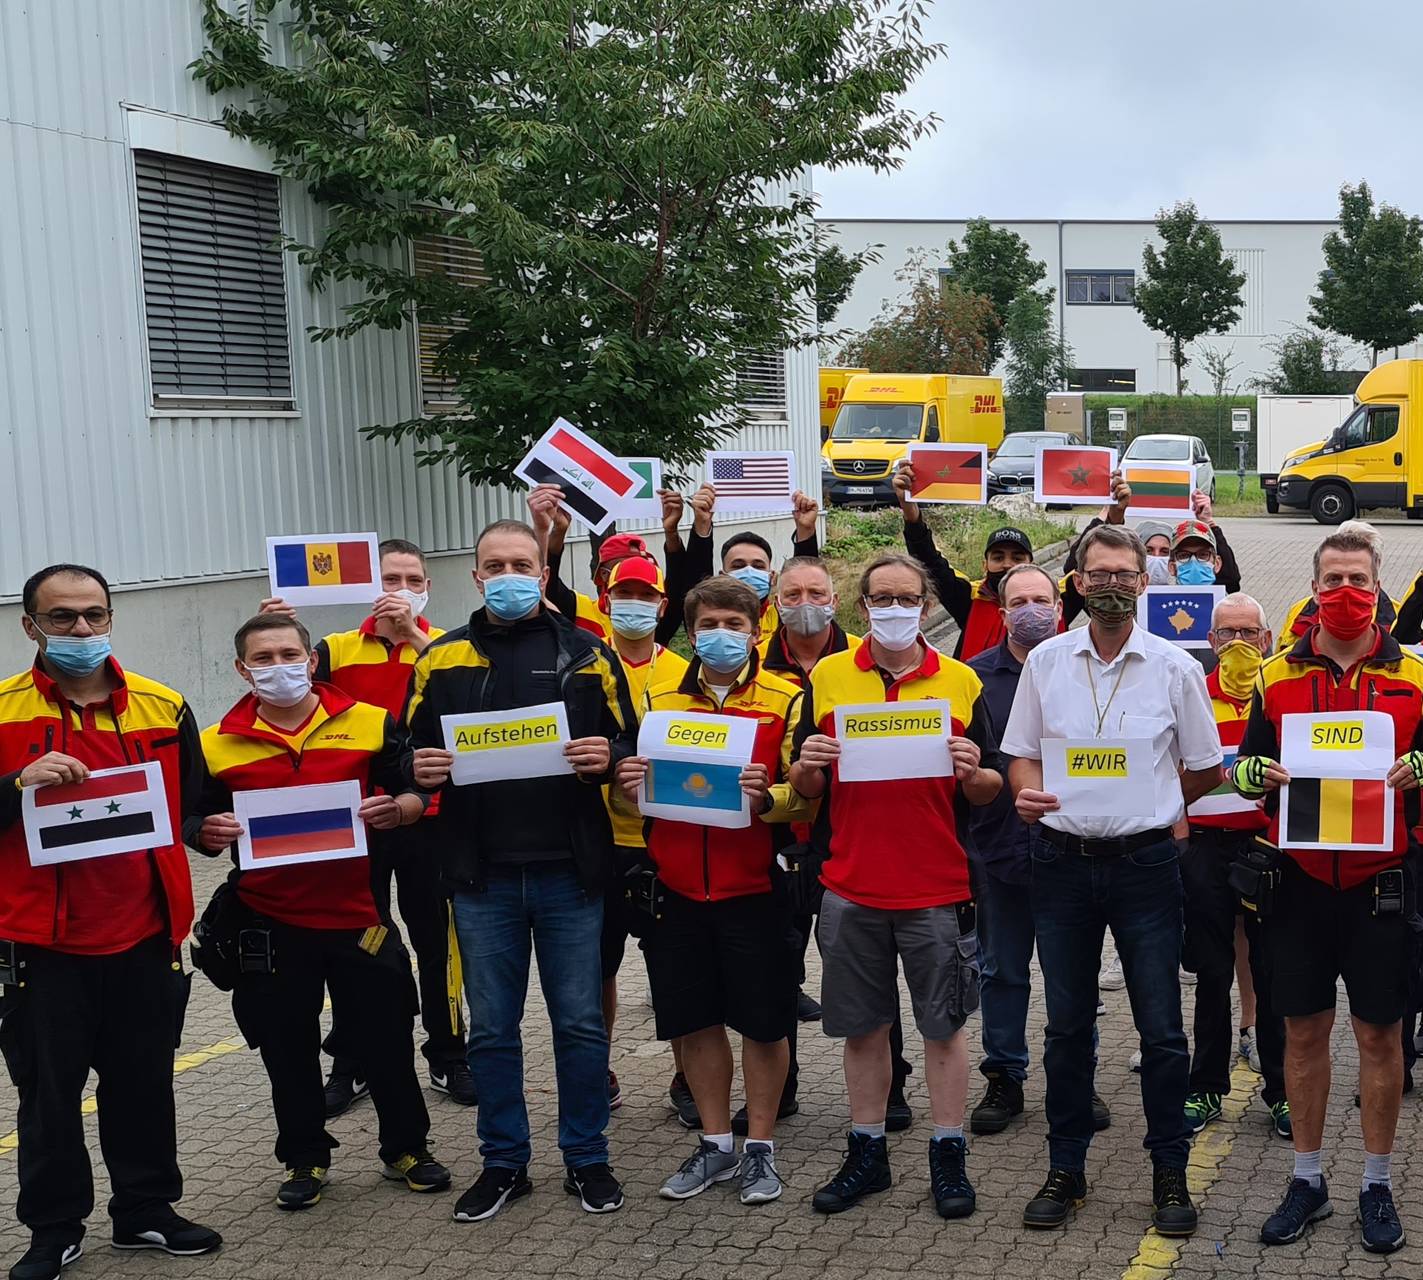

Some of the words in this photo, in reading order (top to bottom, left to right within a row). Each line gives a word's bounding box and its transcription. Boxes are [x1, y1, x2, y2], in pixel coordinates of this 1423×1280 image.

[974, 395, 999, 413] DHL
[995, 530, 1021, 539] BOSS
[845, 715, 942, 734] Rassismus
[455, 721, 558, 747] Aufstehen
[667, 724, 728, 745] Gegen
[1312, 727, 1363, 744] SIND
[1072, 753, 1127, 770] #WIR
